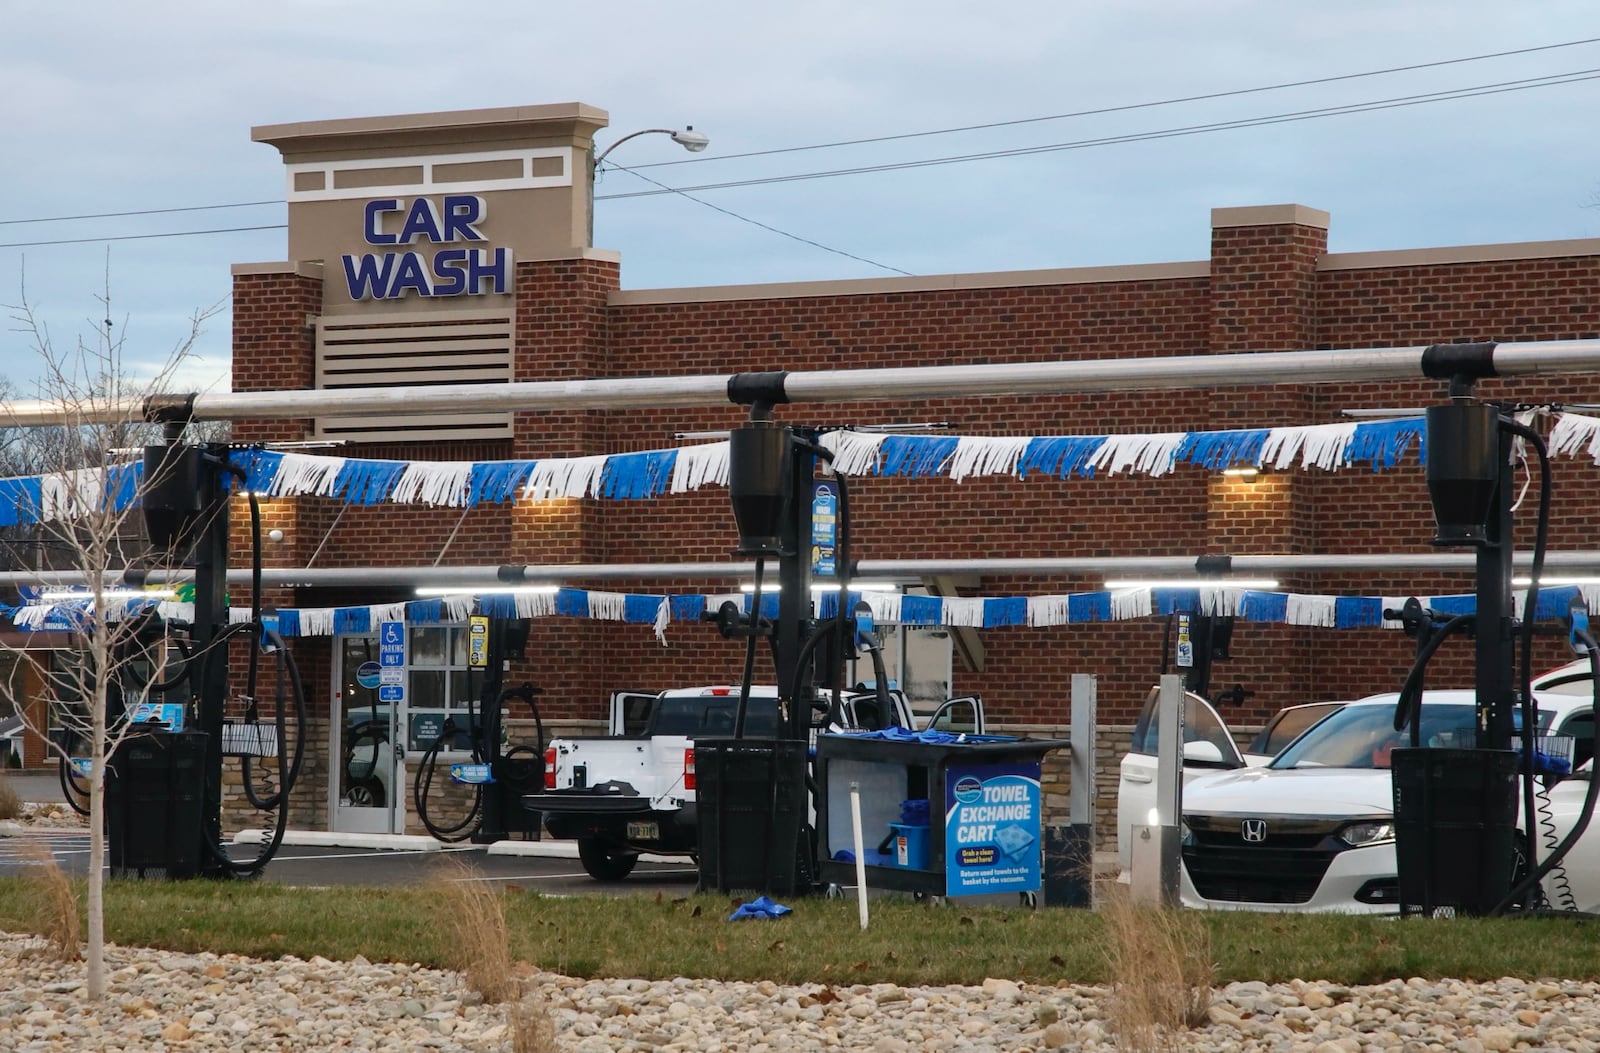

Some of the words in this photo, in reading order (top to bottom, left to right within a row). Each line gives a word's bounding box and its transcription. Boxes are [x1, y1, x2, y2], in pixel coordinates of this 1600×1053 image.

[363, 195, 488, 245] CAR
[341, 247, 512, 301] WASH
[381, 644, 404, 653] PARKING
[385, 654, 400, 664] ONLY
[983, 785, 1030, 803] TOWEL
[960, 804, 1032, 823] EXCHANGE
[957, 824, 996, 843] CART
[961, 849, 975, 857] Grab
[982, 877, 990, 886] by
